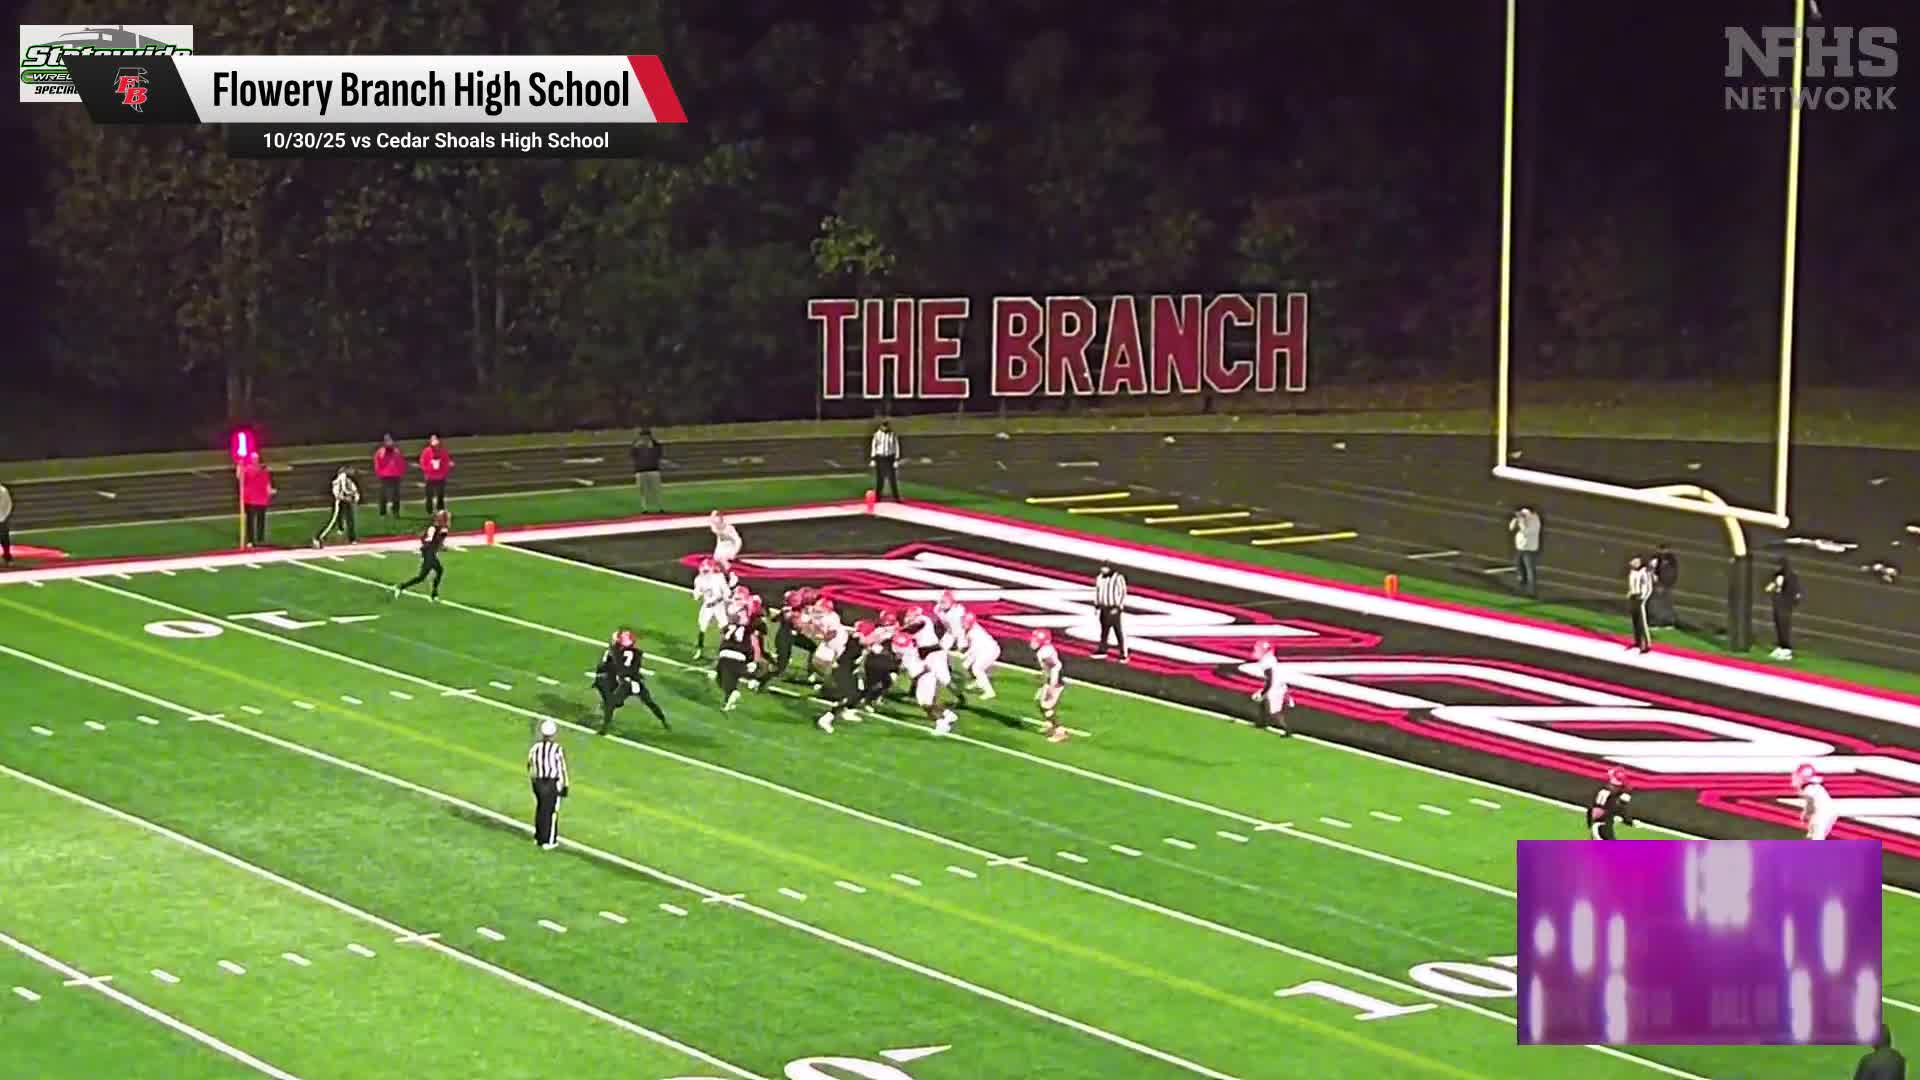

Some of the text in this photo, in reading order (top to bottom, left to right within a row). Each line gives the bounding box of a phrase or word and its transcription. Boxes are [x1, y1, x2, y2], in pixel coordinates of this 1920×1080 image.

[807, 292, 1308, 400] THE BRANCH
[1273, 961, 1518, 1021] 10
